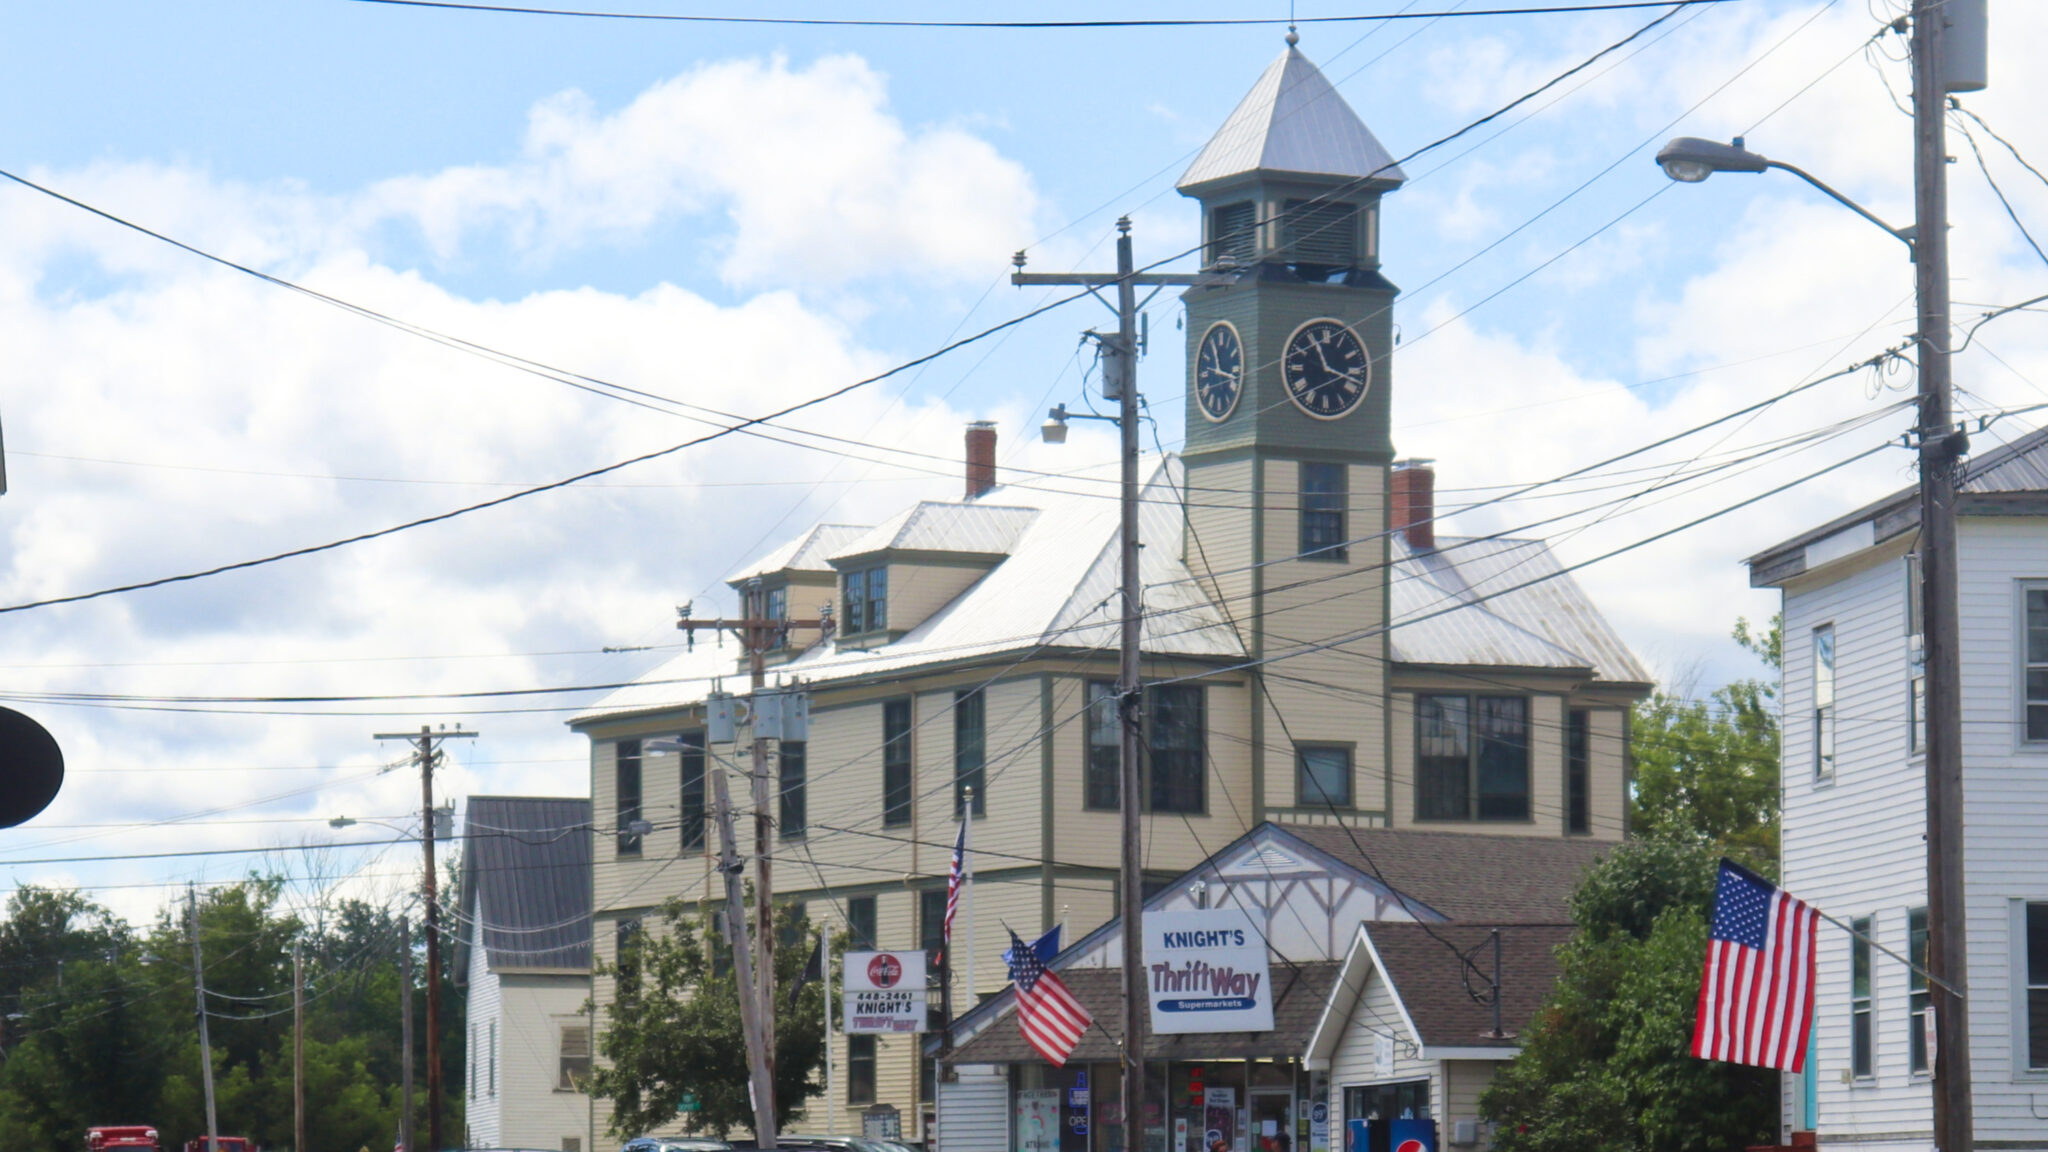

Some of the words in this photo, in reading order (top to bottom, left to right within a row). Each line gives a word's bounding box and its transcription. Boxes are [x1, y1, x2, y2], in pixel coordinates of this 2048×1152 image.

[1163, 929, 1245, 948] KNIGHT'S
[856, 1001, 912, 1014] KNIGHT'S
[1178, 1000, 1242, 1010] Supermarkets
[1069, 1115, 1088, 1127] OPE
